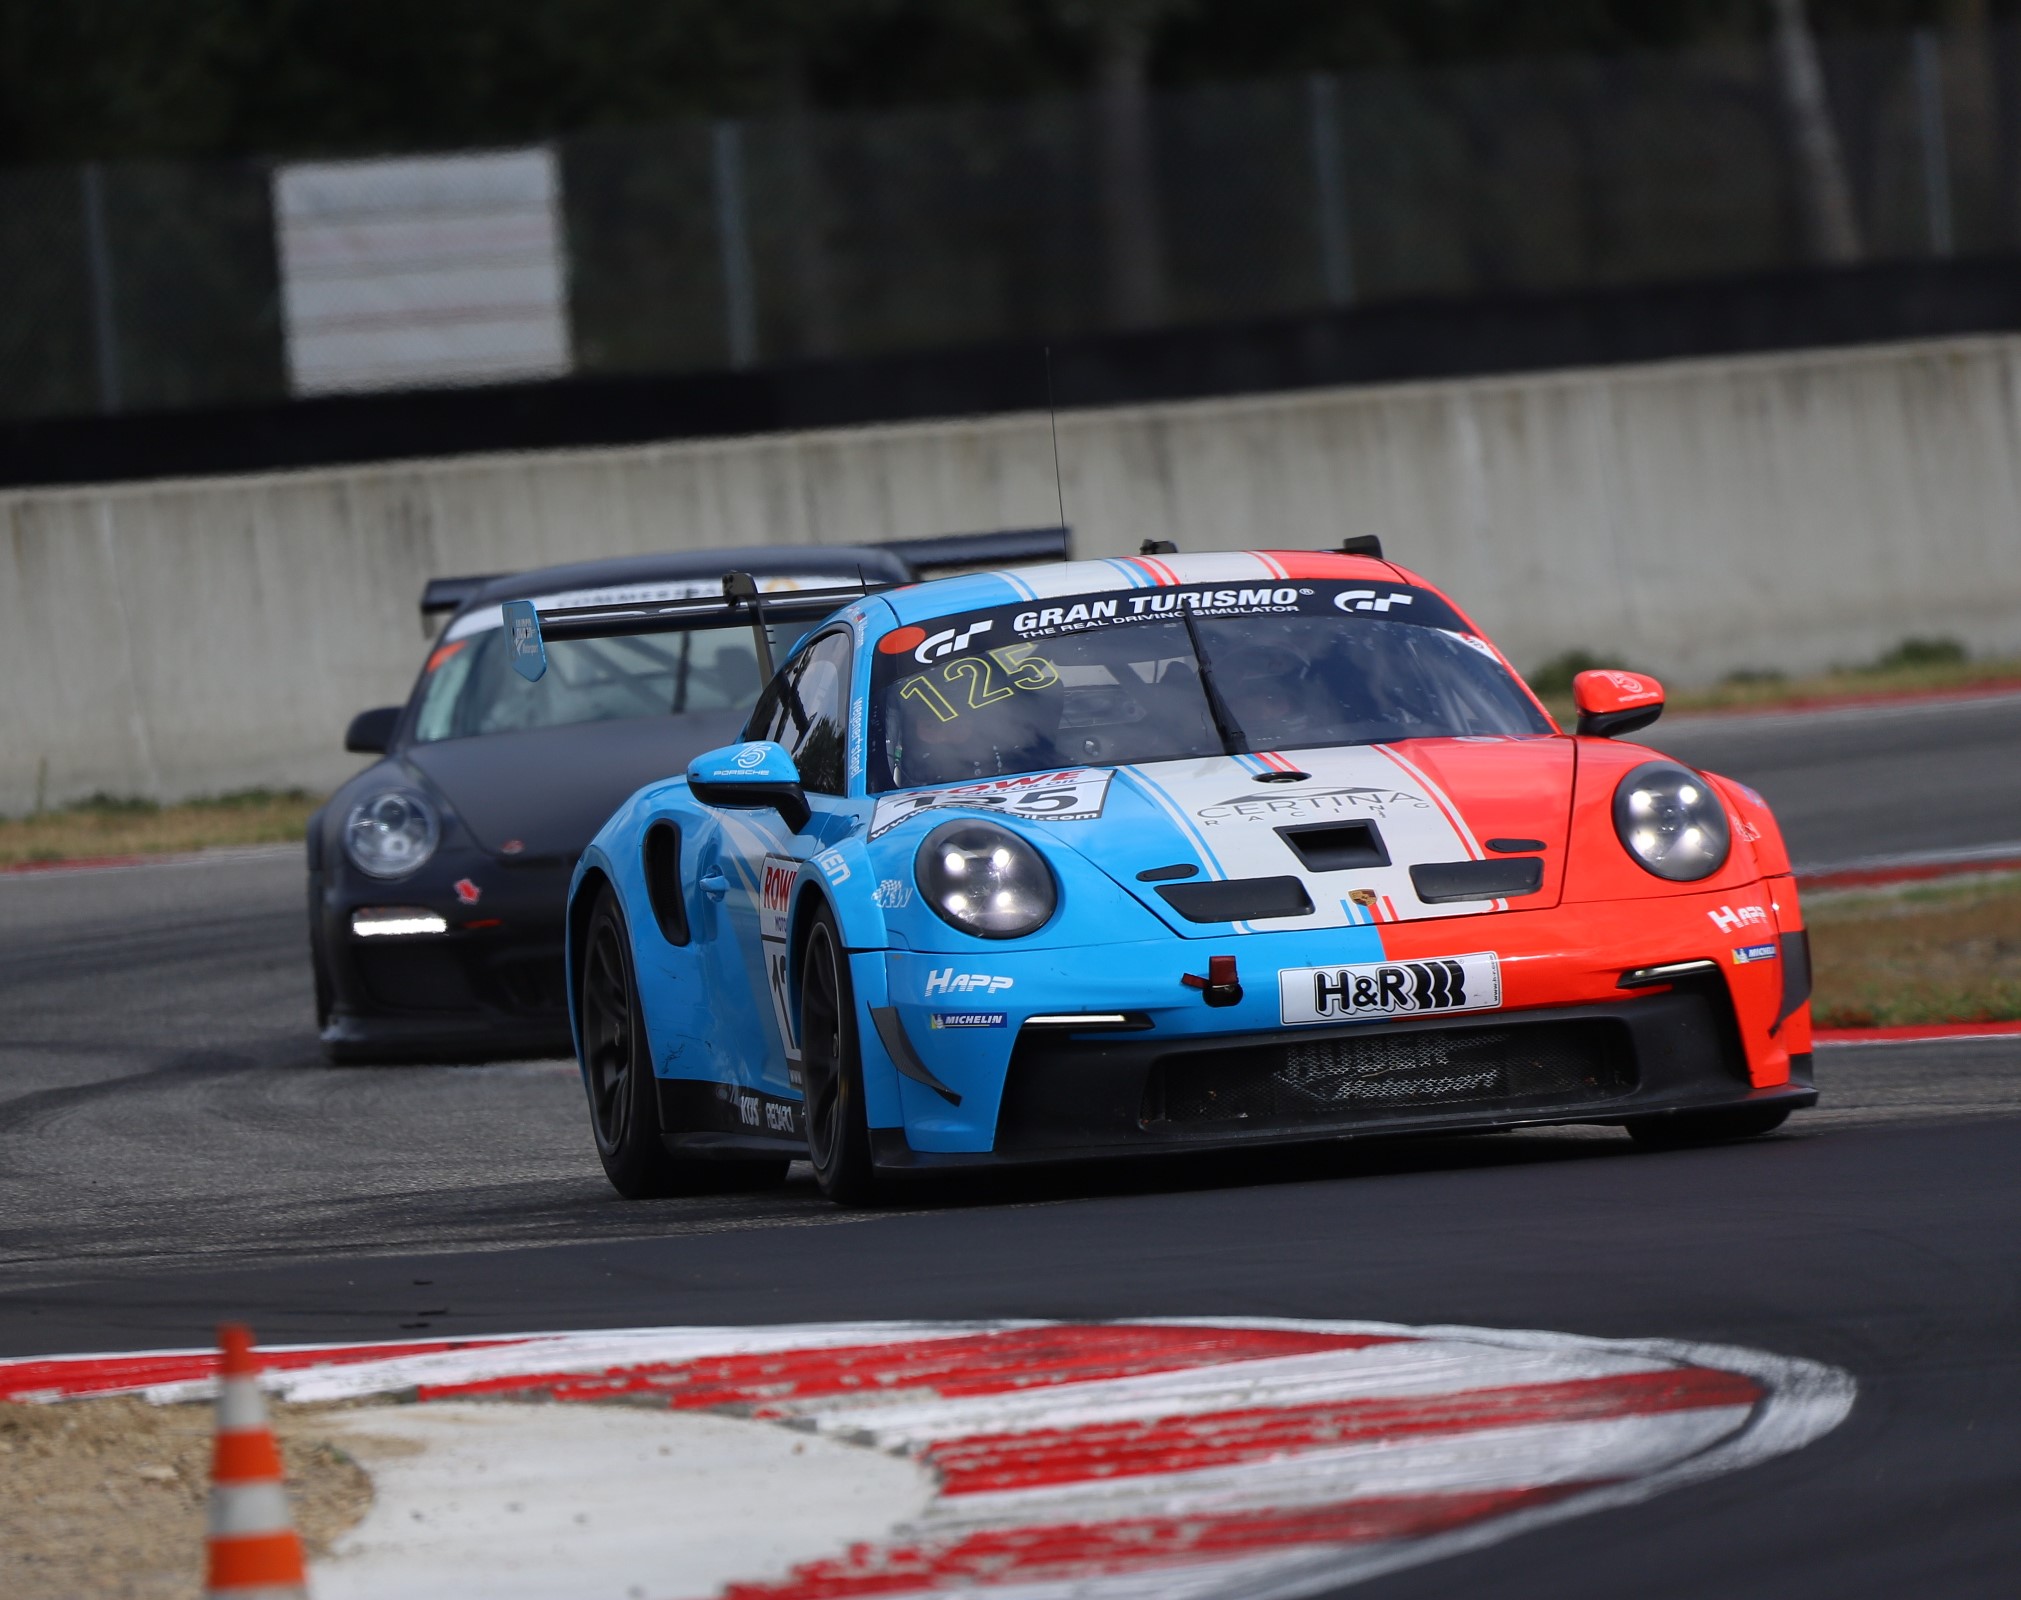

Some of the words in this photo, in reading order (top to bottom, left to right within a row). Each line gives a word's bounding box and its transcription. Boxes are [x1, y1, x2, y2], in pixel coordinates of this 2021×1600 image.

[1012, 599, 1118, 633] GRAN
[1018, 627, 1056, 639] THE
[1061, 620, 1109, 632] REAL
[1112, 610, 1186, 624] DRIVING
[1192, 605, 1300, 616] SIMULATOR
[900, 642, 1059, 723] 125
[907, 769, 1085, 796] ROWE
[965, 783, 1040, 795] MOTOR
[1048, 778, 1077, 787] OIL
[1197, 792, 1425, 819] CERTINA
[1204, 802, 1430, 826] RACING
[925, 968, 1014, 997] HAPP
[1315, 967, 1412, 1013] H&R
[945, 1015, 1002, 1024] MICHELIN
